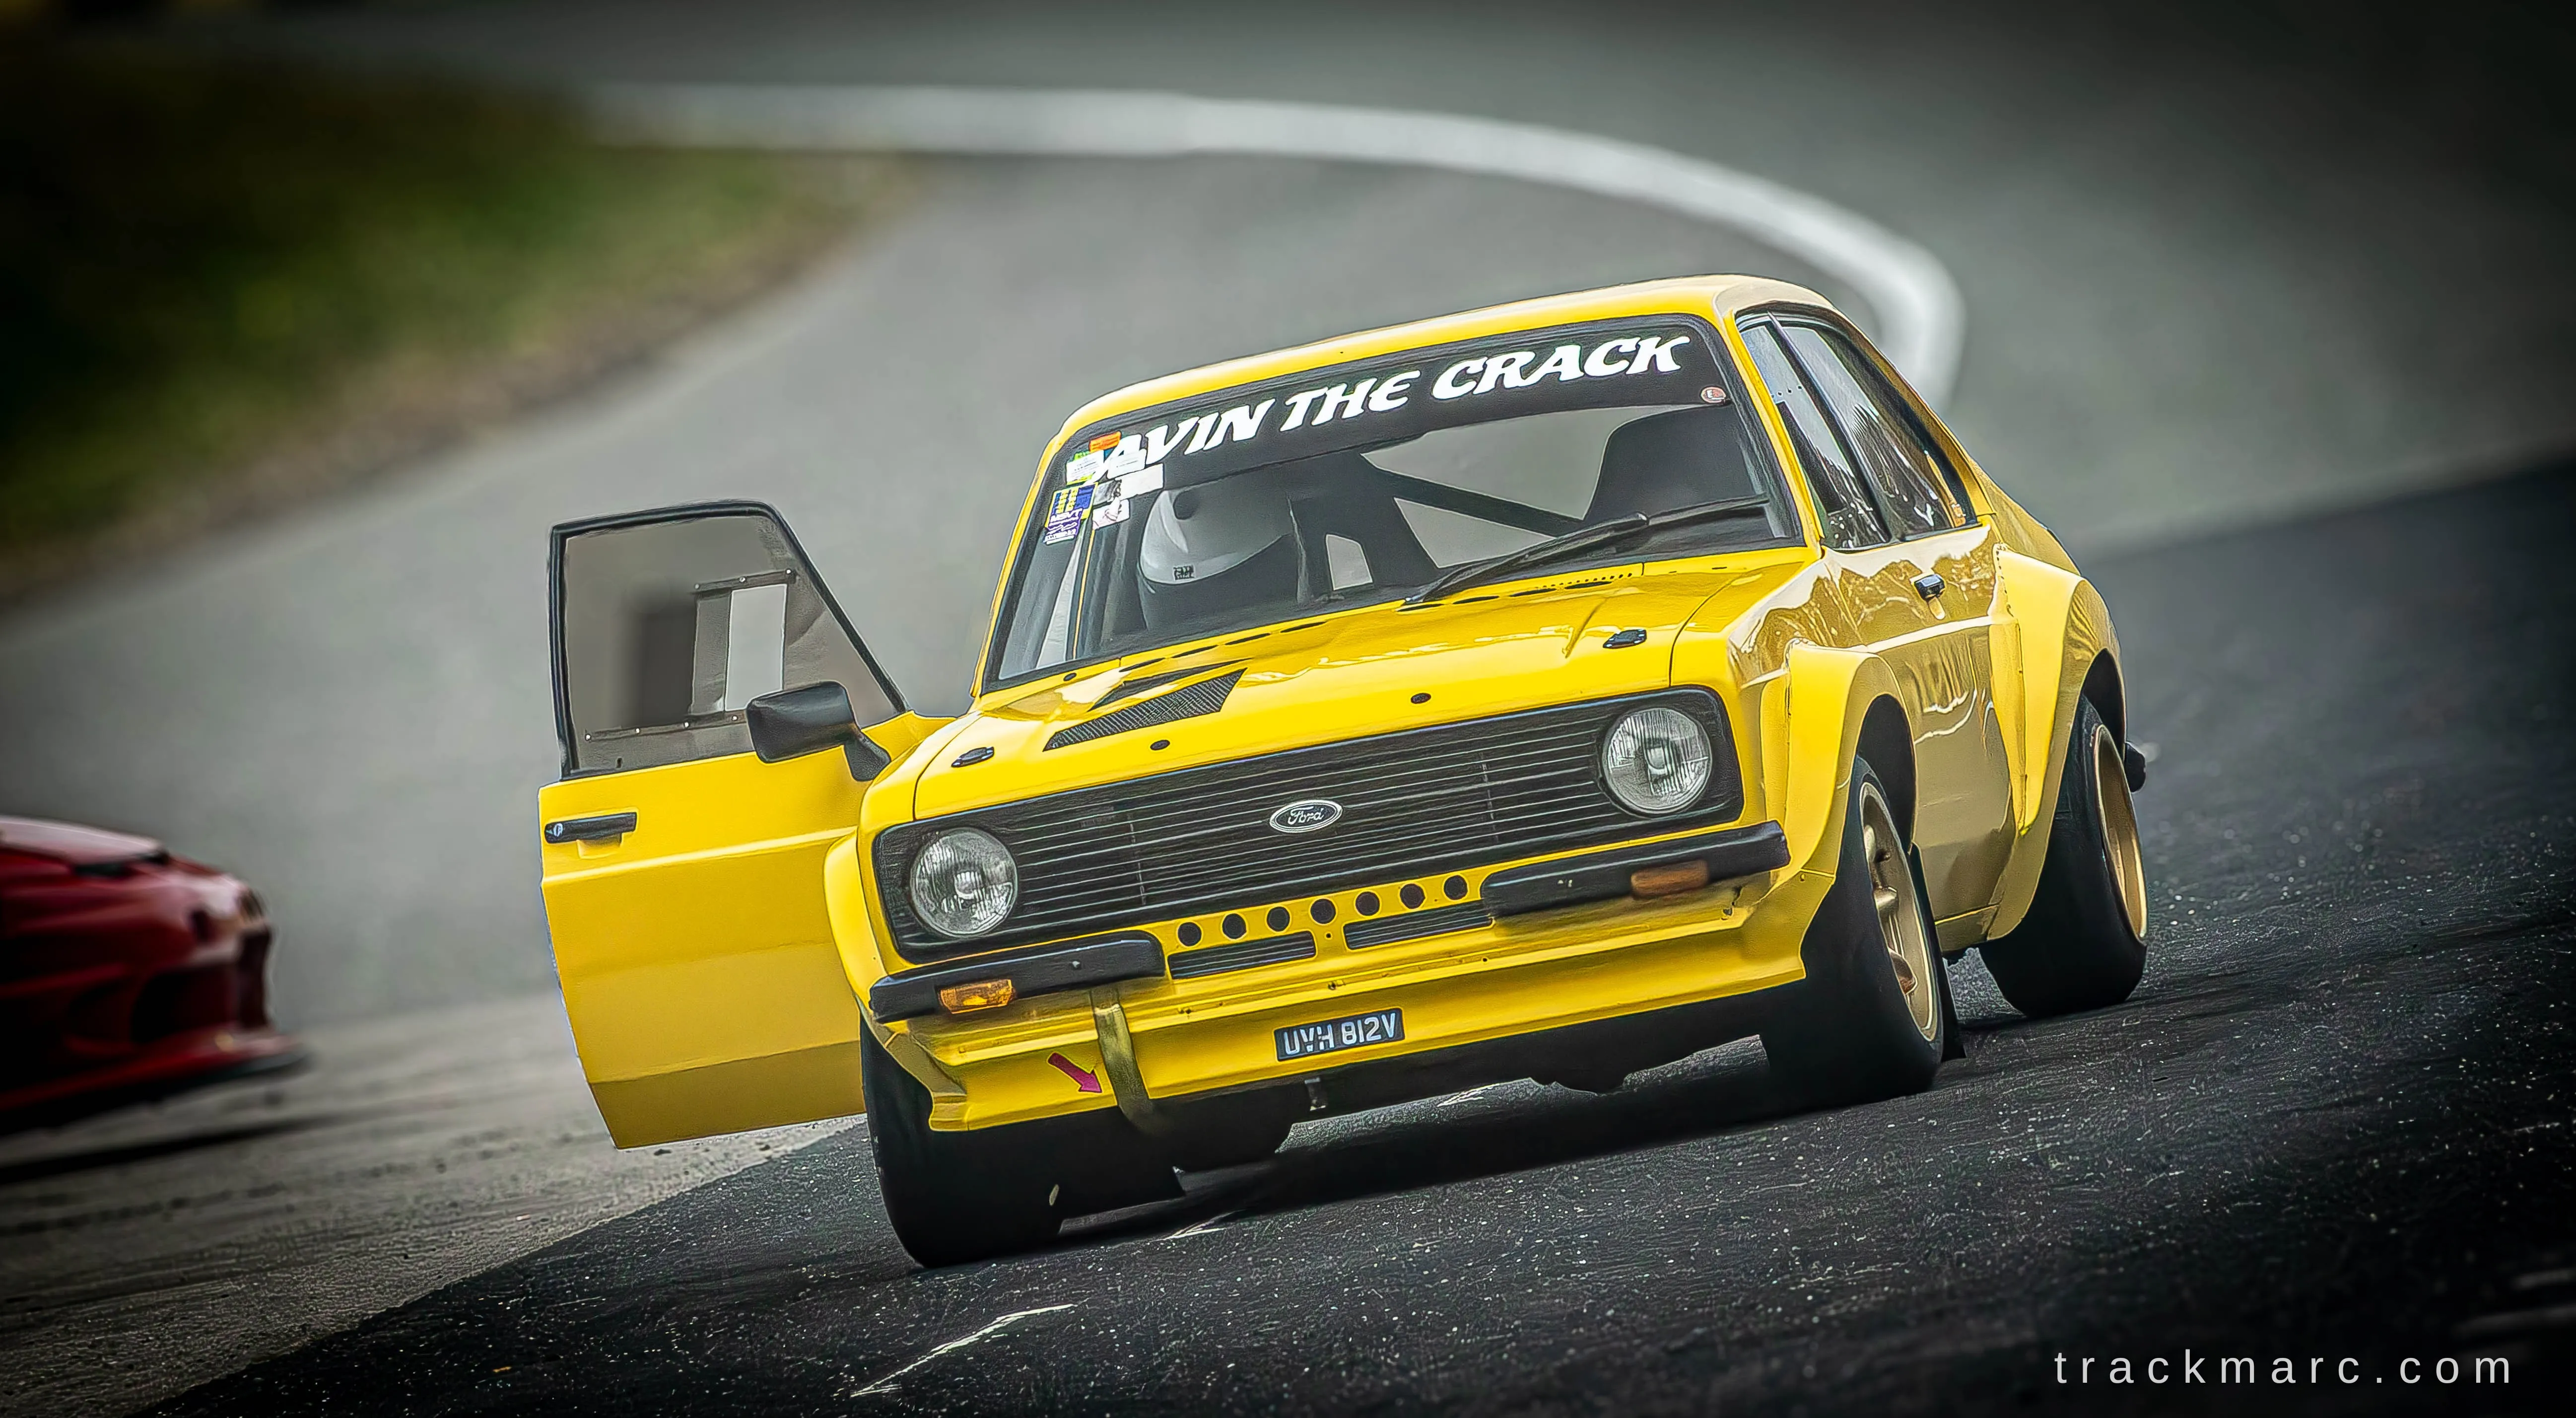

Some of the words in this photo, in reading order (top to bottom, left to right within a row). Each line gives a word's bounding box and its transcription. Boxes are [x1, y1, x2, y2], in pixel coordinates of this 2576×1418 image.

[1280, 370, 1421, 432] THE
[1432, 336, 1691, 400] CRACK
[1288, 806, 1325, 825] Ford
[1284, 1024, 1335, 1056] UVH
[1341, 1012, 1396, 1045] 812V
